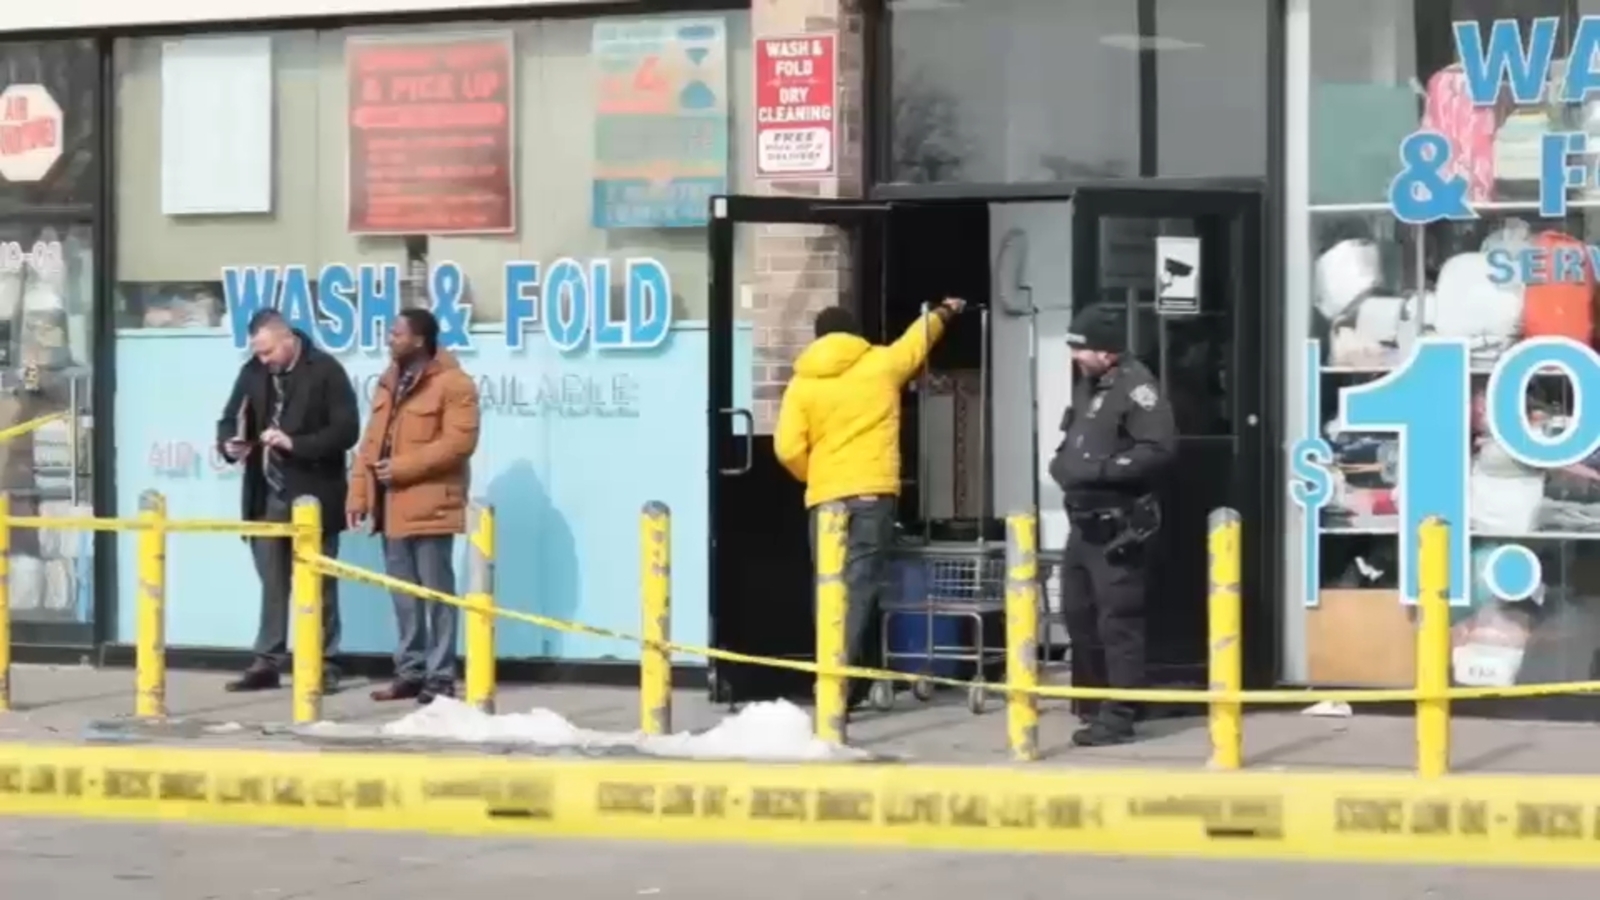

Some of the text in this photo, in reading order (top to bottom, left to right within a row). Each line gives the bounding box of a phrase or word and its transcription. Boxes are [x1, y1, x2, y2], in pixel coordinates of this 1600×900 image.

[766, 39, 823, 58] WASH &
[775, 59, 814, 76] FOLD
[1452, 15, 1600, 106] WA
[779, 86, 809, 104] DRY
[758, 105, 831, 122] CLEANING
[774, 132, 817, 143] FREE
[1388, 131, 1600, 224] & F
[222, 256, 673, 352] WASH & FOLD
[479, 373, 638, 414] AILABLE
